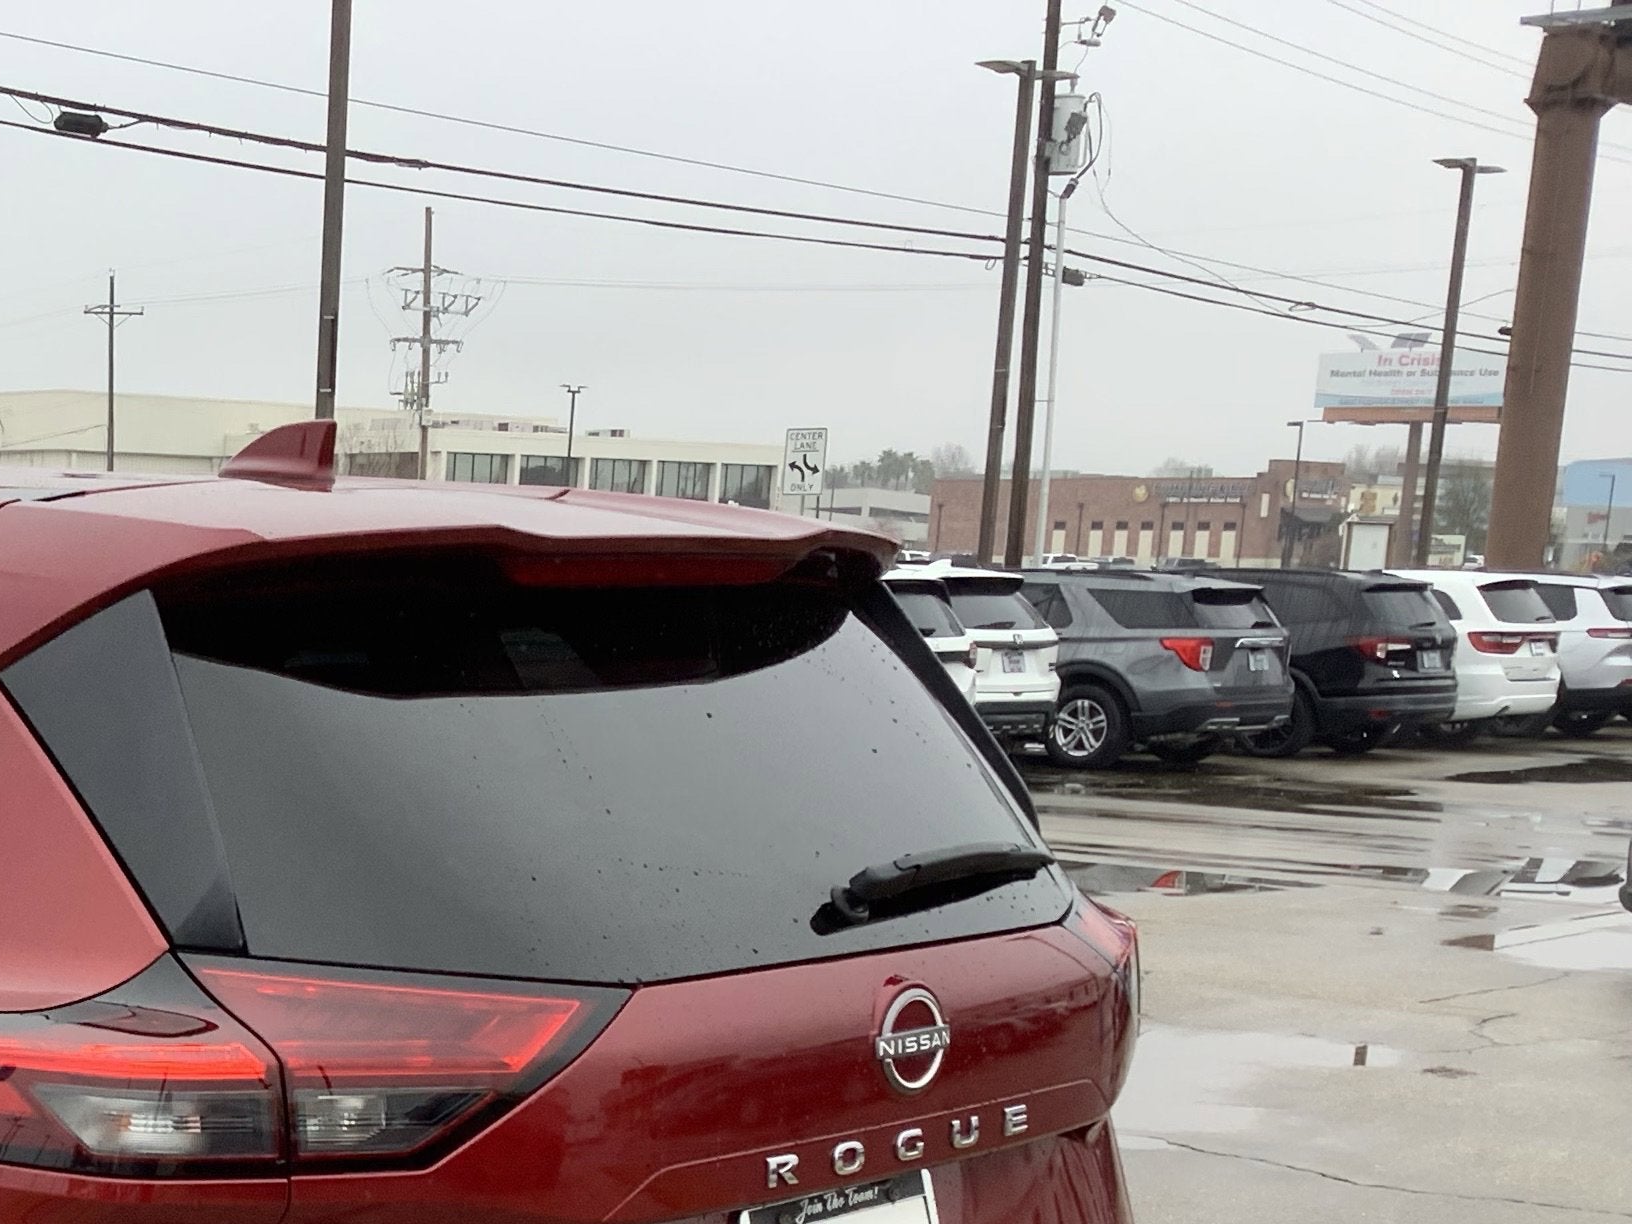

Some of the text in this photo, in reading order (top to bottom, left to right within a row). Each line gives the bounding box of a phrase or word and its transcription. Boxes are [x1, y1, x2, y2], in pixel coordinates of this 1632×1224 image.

[1377, 355, 1393, 366] In
[1329, 369, 1367, 378] Mental
[1369, 369, 1404, 377] Health
[1479, 368, 1500, 377] Use
[789, 431, 824, 441] CENTER
[794, 441, 818, 450] LANE
[790, 483, 814, 492] ONLY
[878, 1030, 950, 1057] NISSAN
[766, 1104, 1029, 1189] ROGUE
[795, 1186, 879, 1224] Join The Team!
